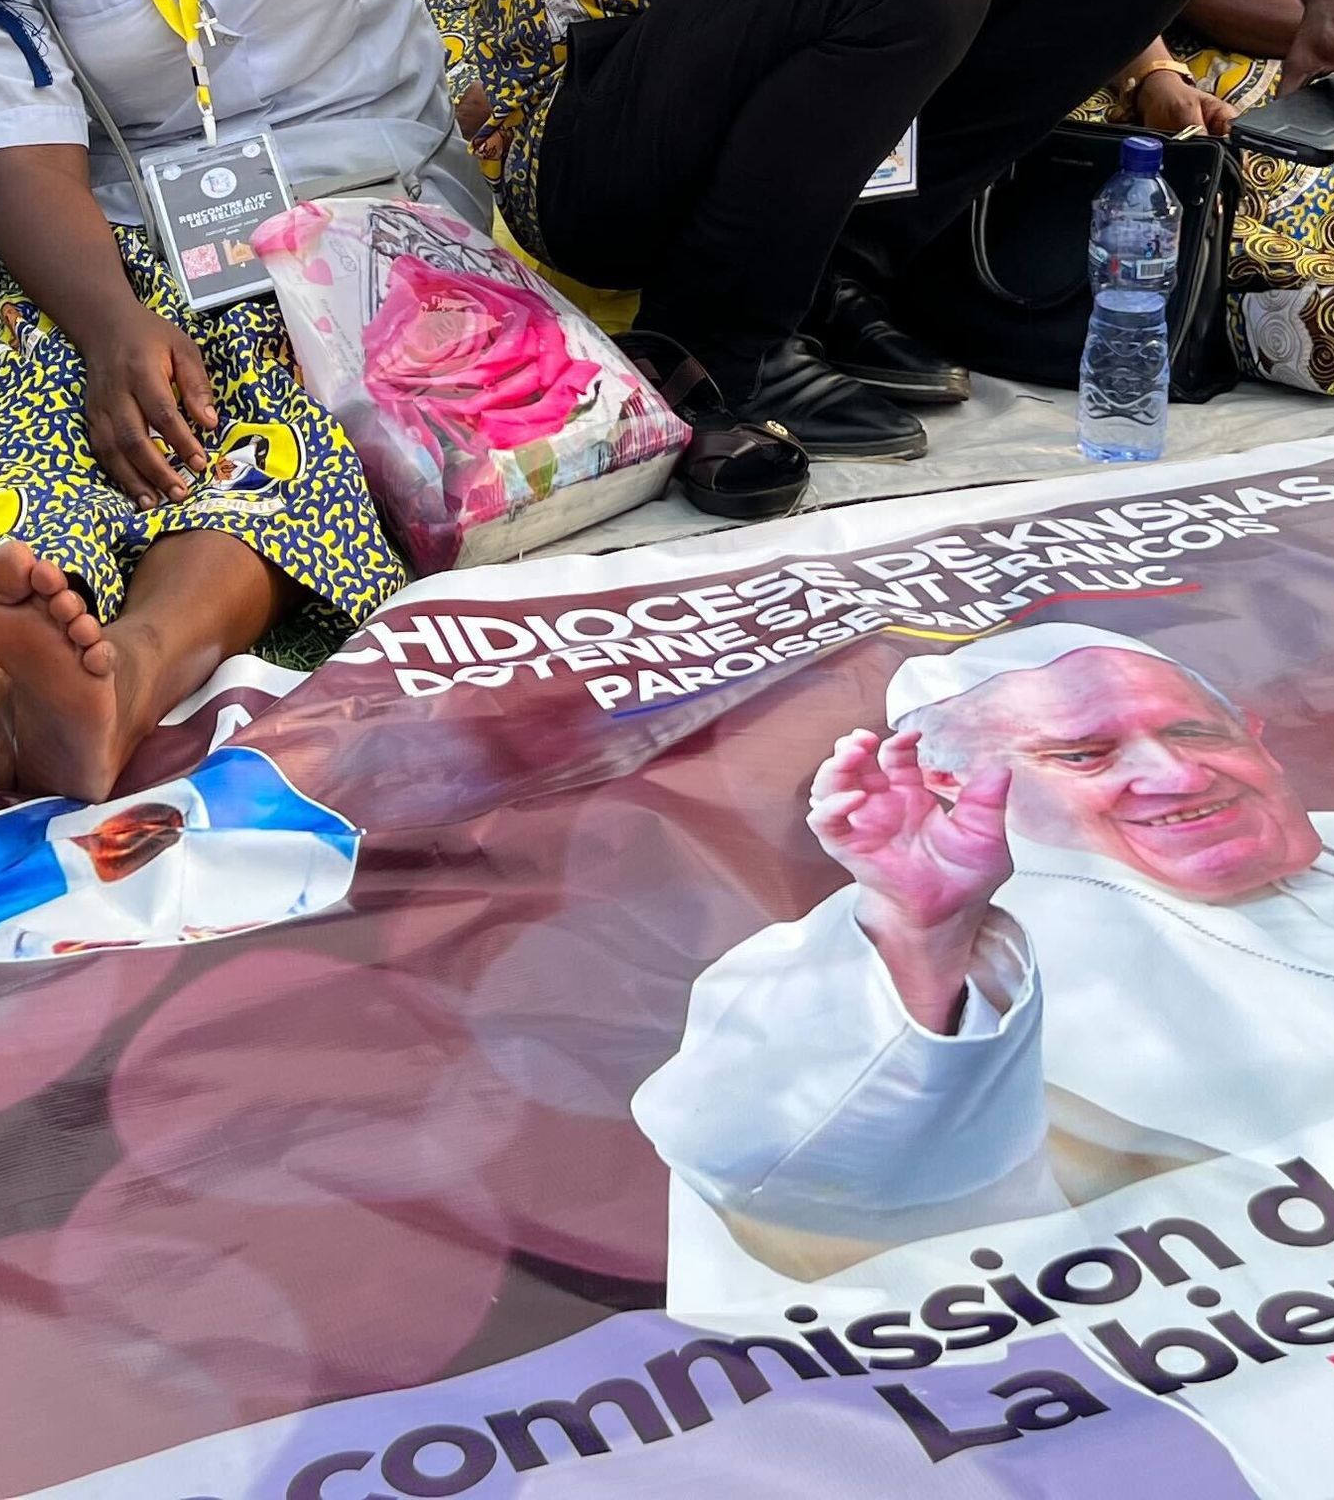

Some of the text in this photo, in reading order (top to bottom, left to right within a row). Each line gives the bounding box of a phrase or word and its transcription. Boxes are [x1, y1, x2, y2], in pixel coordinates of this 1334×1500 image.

[178, 191, 274, 224] RENCONTRE AVEC
[189, 218, 210, 229] LES
[210, 201, 267, 223] RELIGIEUX
[852, 535, 992, 581] DE
[756, 571, 951, 632] SAINT
[585, 565, 1183, 711] PAROISSE SAINT LUC
[286, 1212, 1238, 1500] commission
[874, 1363, 1110, 1464] La
